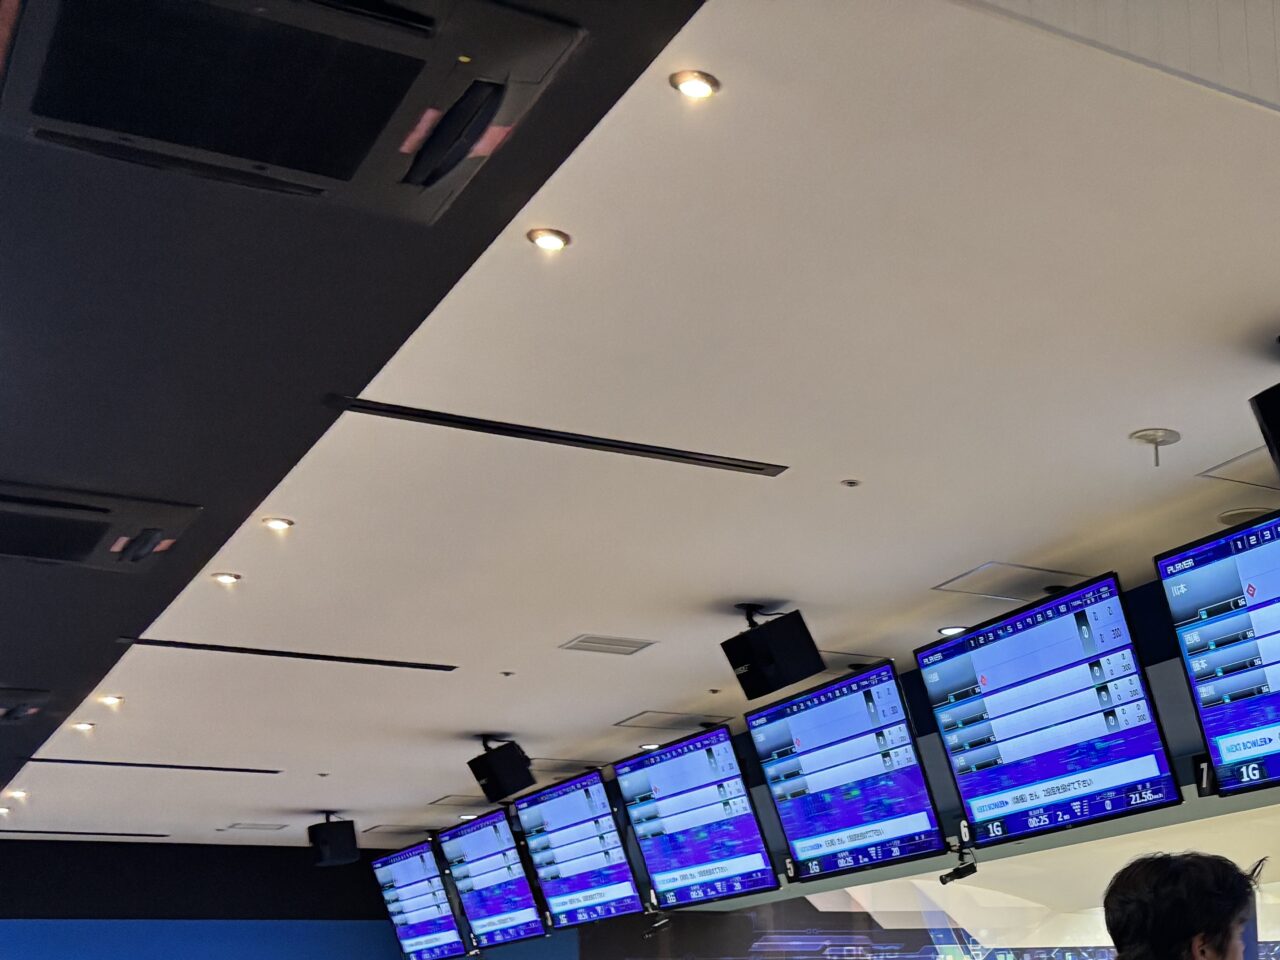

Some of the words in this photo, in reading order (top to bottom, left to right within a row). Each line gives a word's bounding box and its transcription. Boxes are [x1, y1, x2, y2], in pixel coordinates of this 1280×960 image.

[1240, 763, 1260, 782] 1G
[960, 820, 969, 841] 6
[987, 821, 1002, 837] 1G
[785, 858, 794, 877] 5
